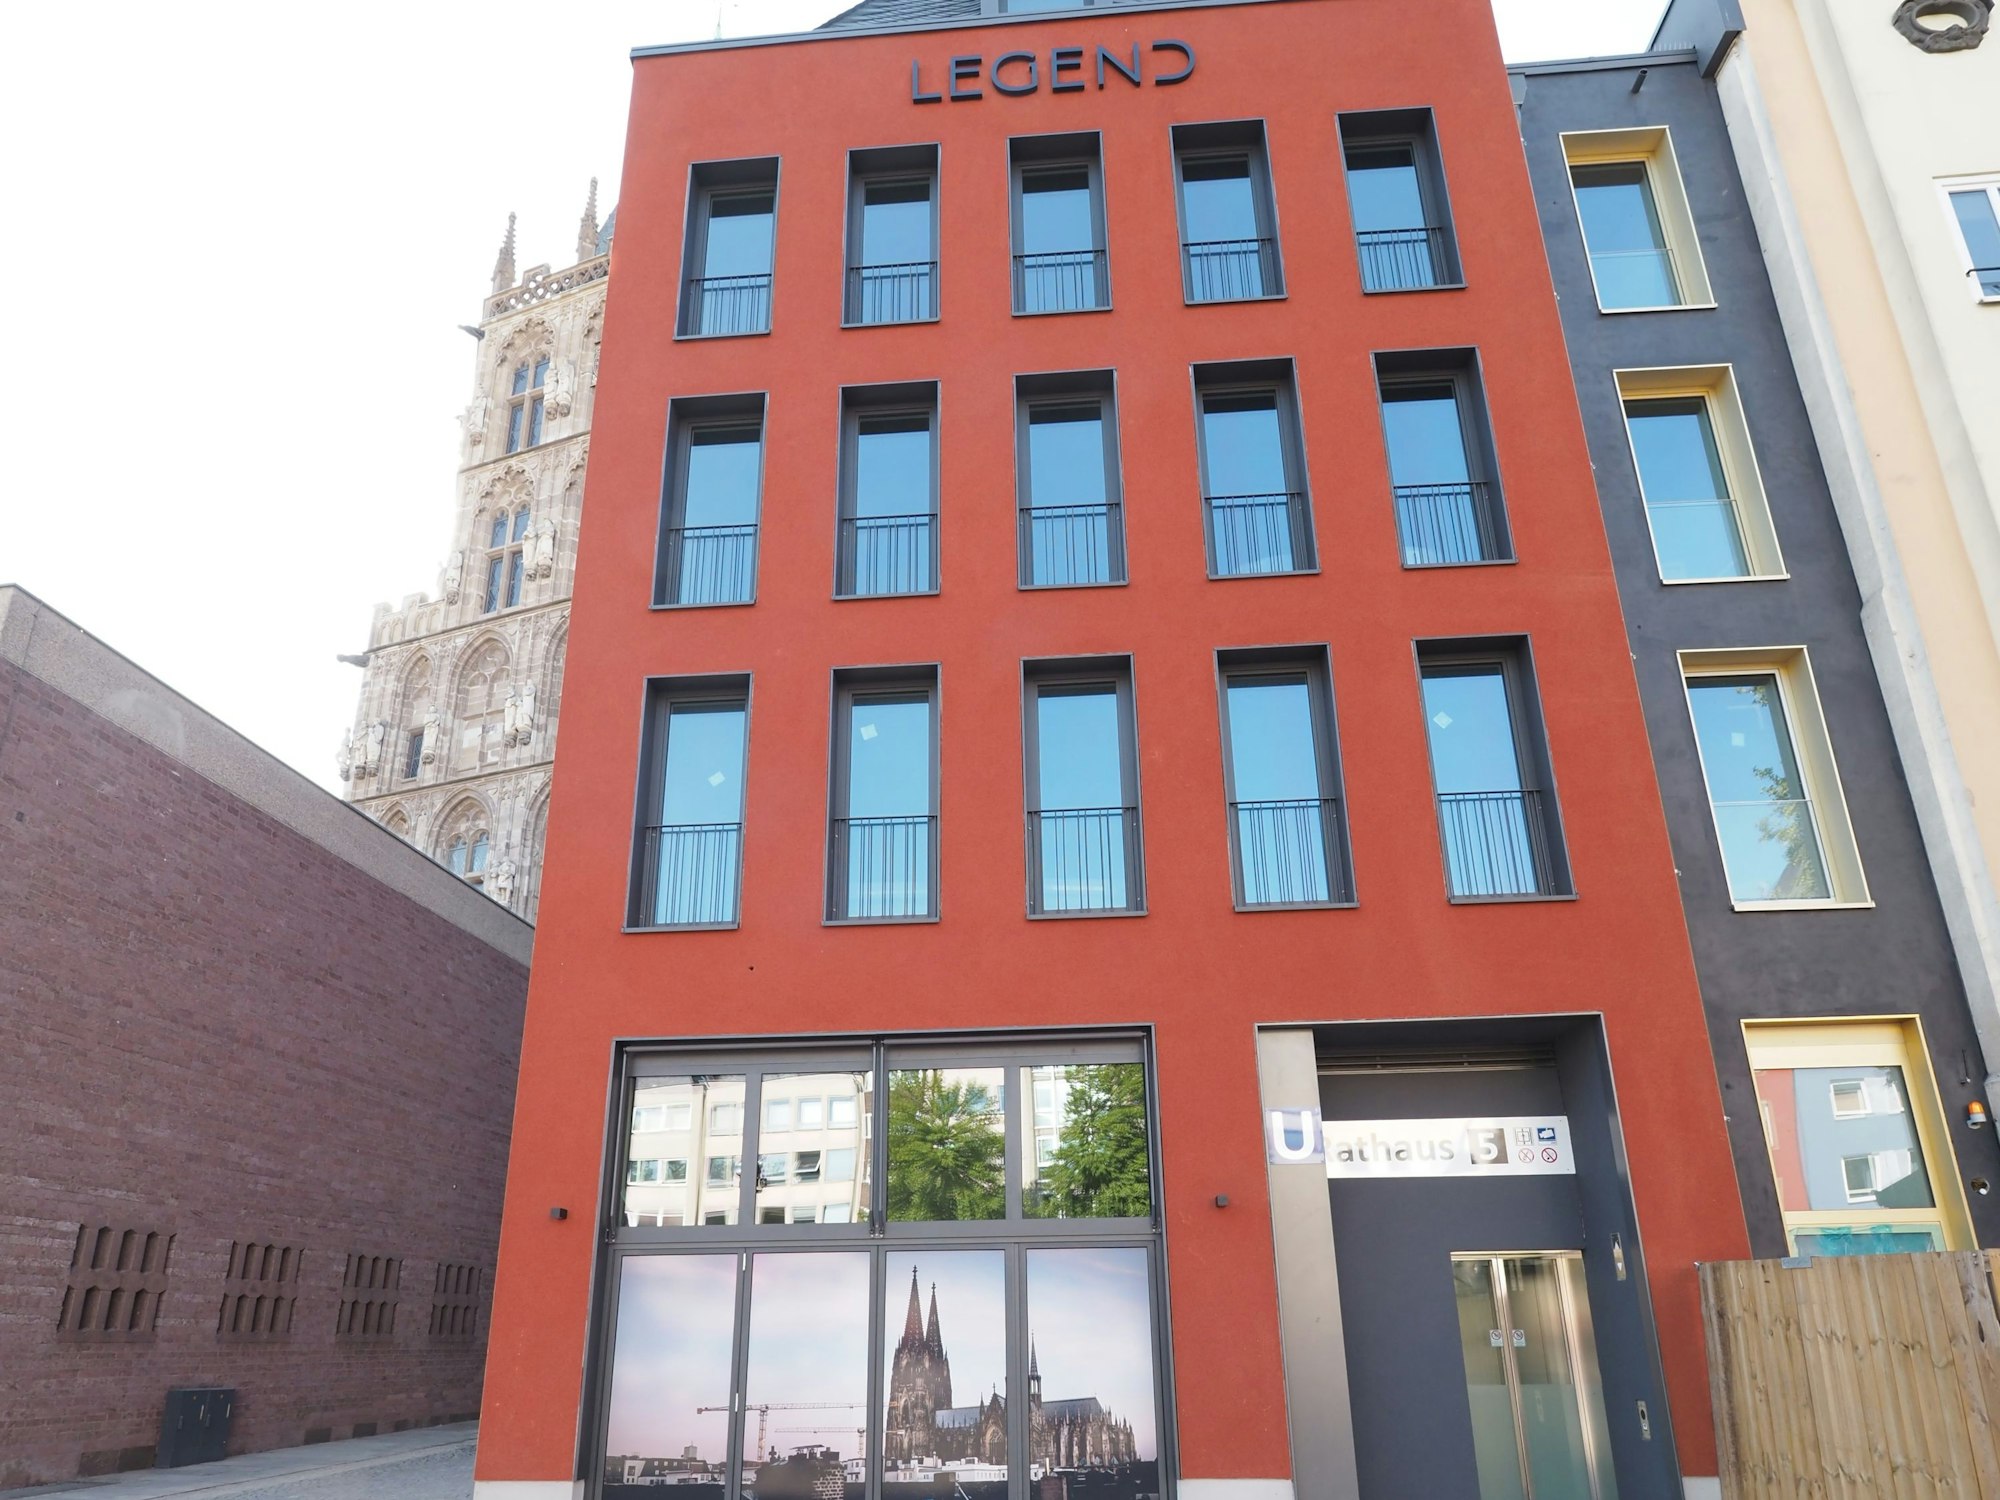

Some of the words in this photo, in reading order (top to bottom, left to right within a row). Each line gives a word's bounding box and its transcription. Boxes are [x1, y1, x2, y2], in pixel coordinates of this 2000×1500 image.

[912, 39, 1196, 104] LEGEND
[1271, 1111, 1315, 1160] U
[1477, 1132, 1500, 1161] 5
